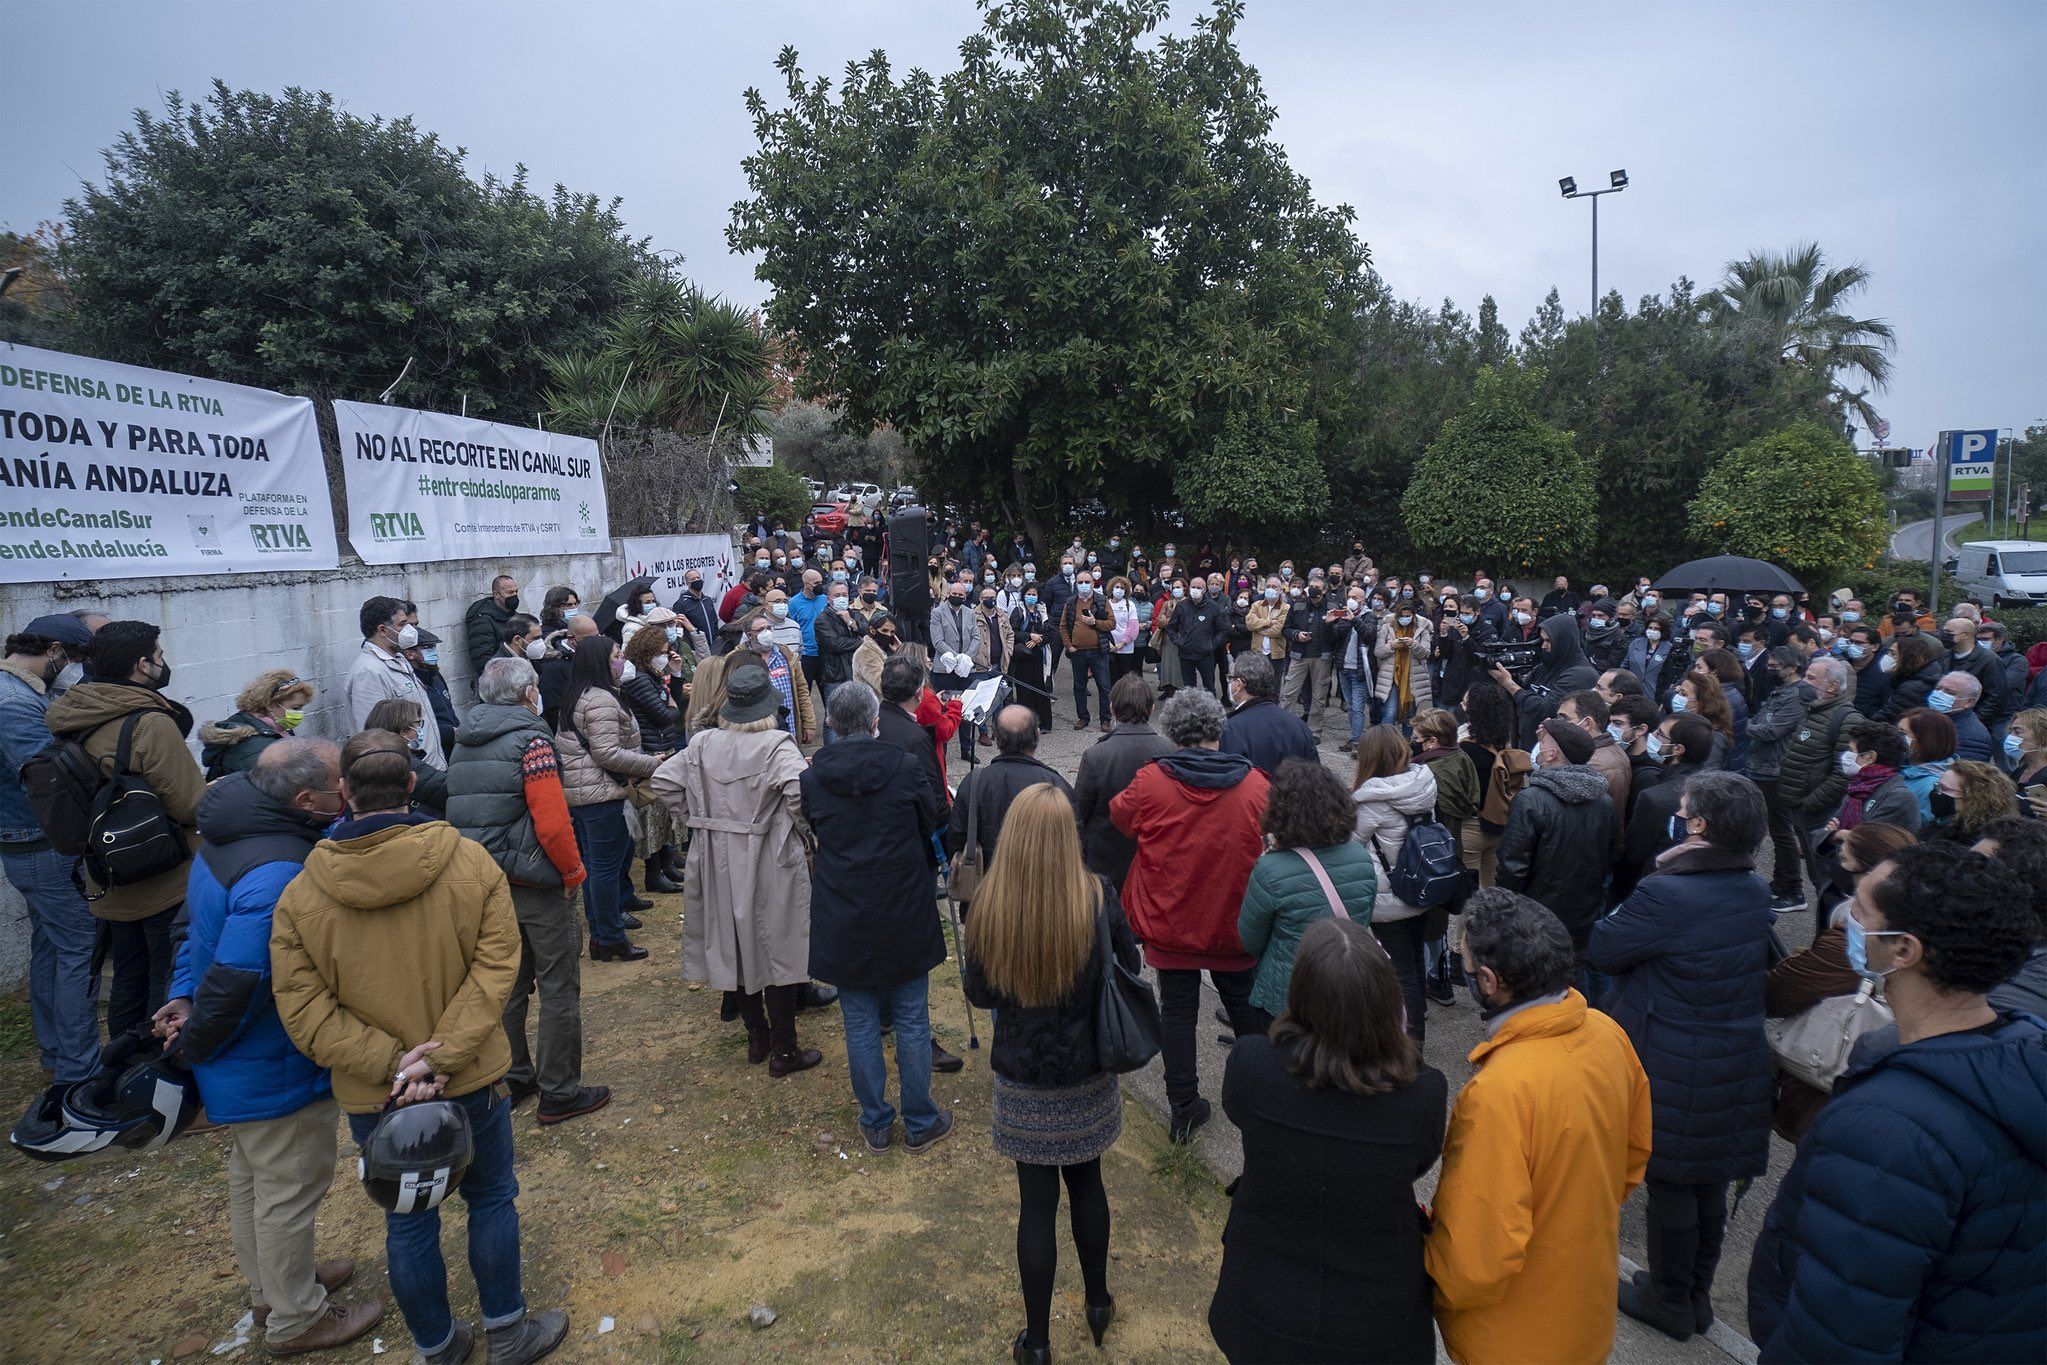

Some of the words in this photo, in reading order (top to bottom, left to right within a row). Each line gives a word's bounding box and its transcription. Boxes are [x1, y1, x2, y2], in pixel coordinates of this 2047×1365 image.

[0, 365, 111, 400] DEFENSA
[116, 383, 144, 405] DE
[148, 389, 173, 409] LA
[177, 393, 224, 416] RTVA
[0, 409, 93, 447] TODA
[97, 420, 118, 449] Y
[127, 424, 205, 456] PARA
[207, 433, 269, 461] TODA
[1962, 434, 1986, 460] P
[355, 432, 386, 461] NO
[391, 436, 418, 462] AL
[419, 438, 496, 469] RECORTE
[498, 448, 520, 471] EN
[522, 451, 566, 476] CANAL
[568, 457, 591, 478] SUR
[85, 464, 233, 497] ANDALUZA
[1955, 466, 1990, 475] RTVA
[239, 493, 295, 503] PLATAFORMA
[297, 495, 308, 503] EN
[418, 474, 560, 504] #entretodasloparamos
[243, 506, 282, 516] DEFENSA
[284, 507, 295, 516] DE
[297, 507, 308, 516] LA
[249, 524, 311, 548] RTVA
[370, 512, 425, 538] RTVA
[478, 523, 513, 533] Intercentros
[514, 524, 520, 532] de
[521, 523, 535, 532] RTVA
[667, 561, 671, 571] A
[673, 559, 684, 571] LOS
[686, 556, 715, 569] RECORTES
[667, 577, 676, 588] EN
[678, 576, 685, 587] LA
